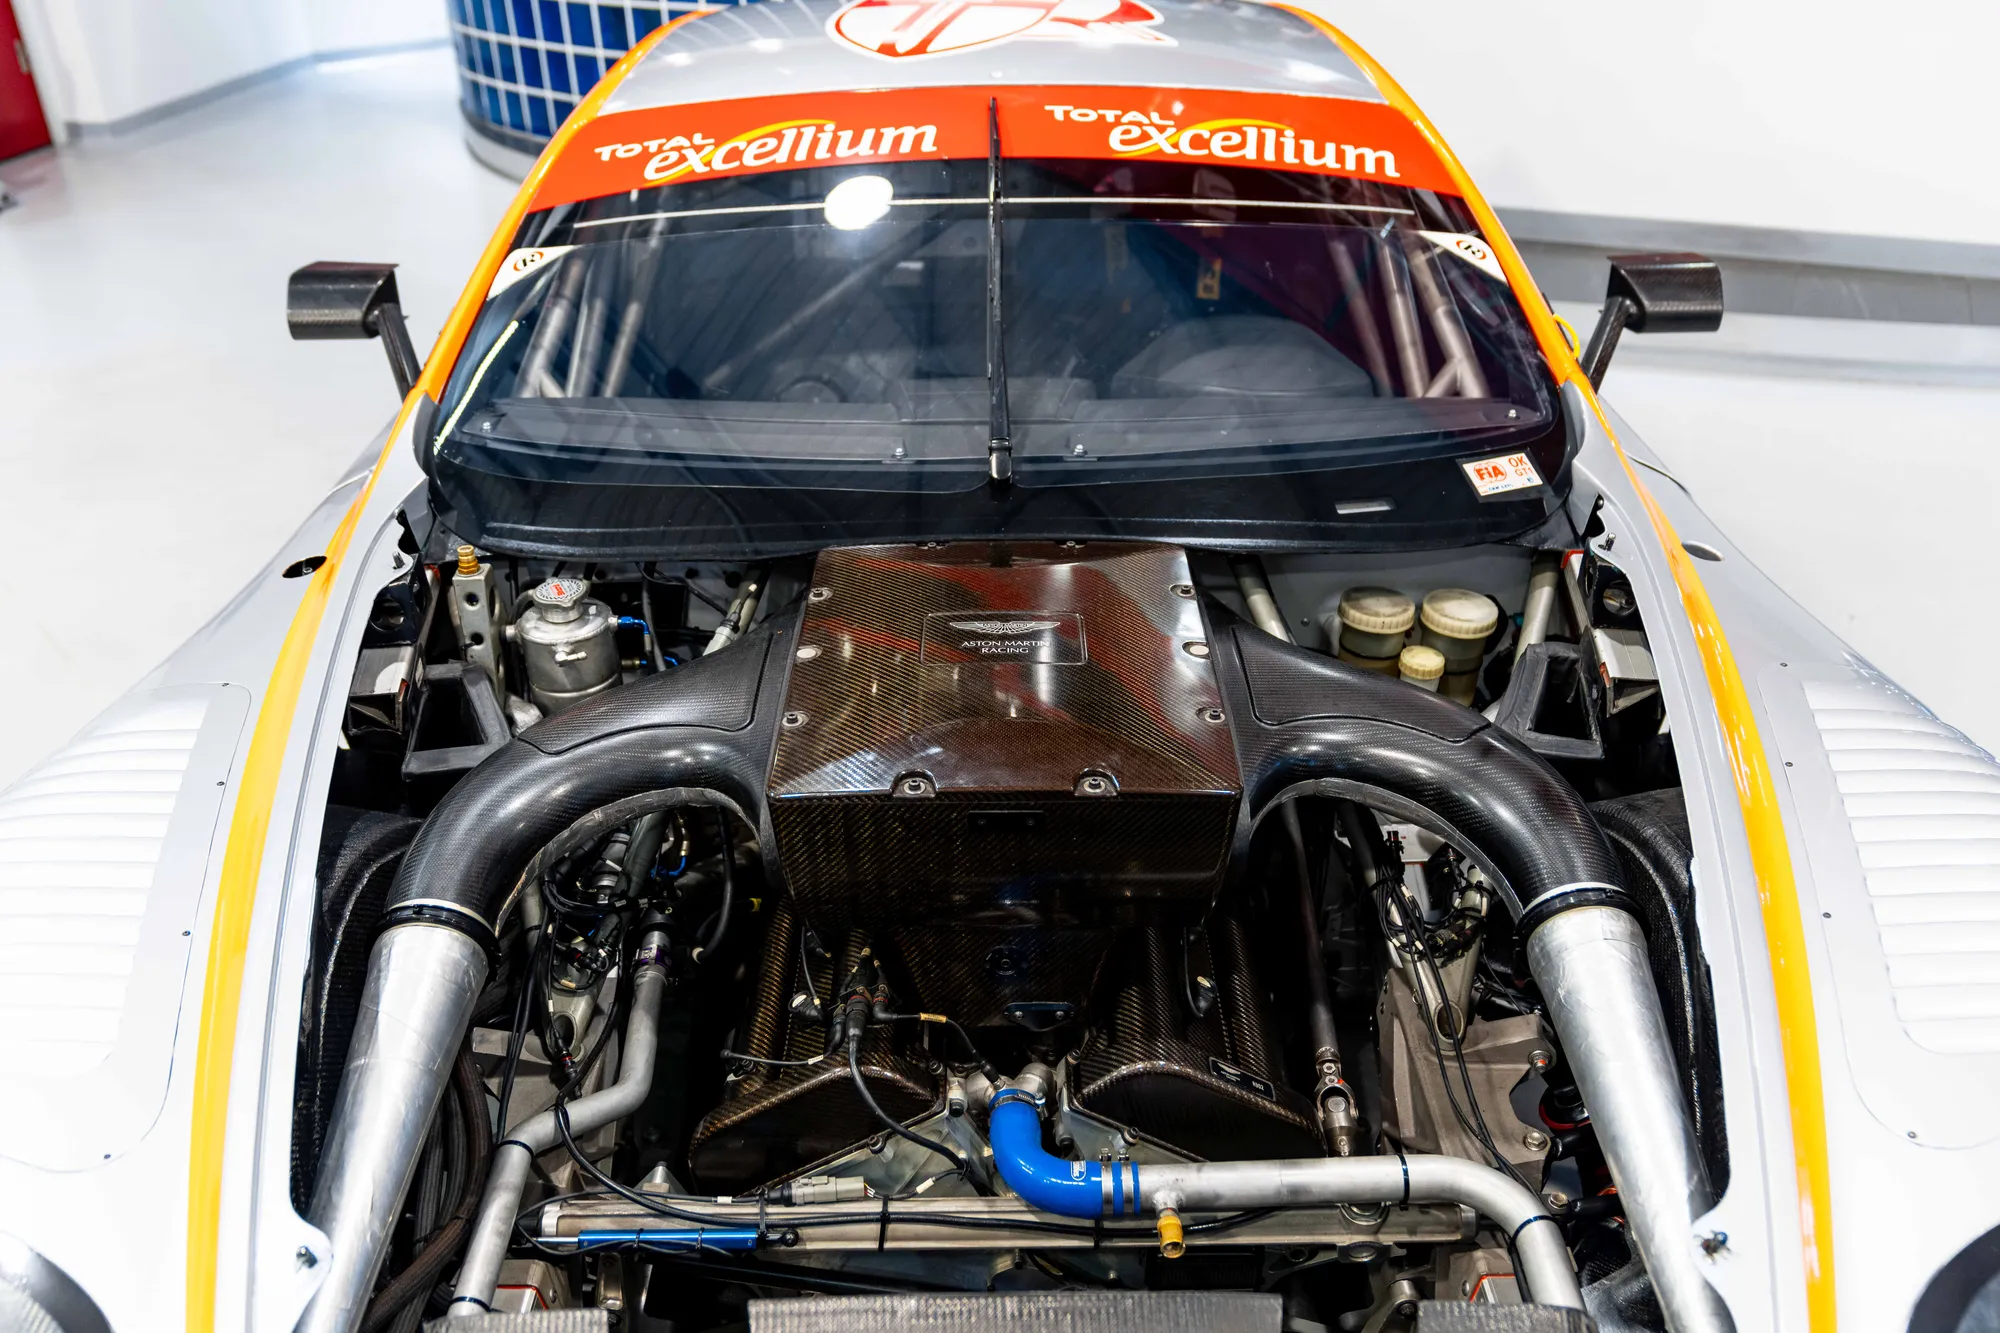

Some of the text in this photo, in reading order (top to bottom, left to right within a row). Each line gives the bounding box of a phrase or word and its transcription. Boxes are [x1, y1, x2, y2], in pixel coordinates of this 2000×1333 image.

[1044, 105, 1174, 126] TOTAL
[594, 133, 715, 161] TOTAL
[643, 124, 938, 180] excellium
[1108, 124, 1400, 178] excellium
[1508, 456, 1527, 467] OK
